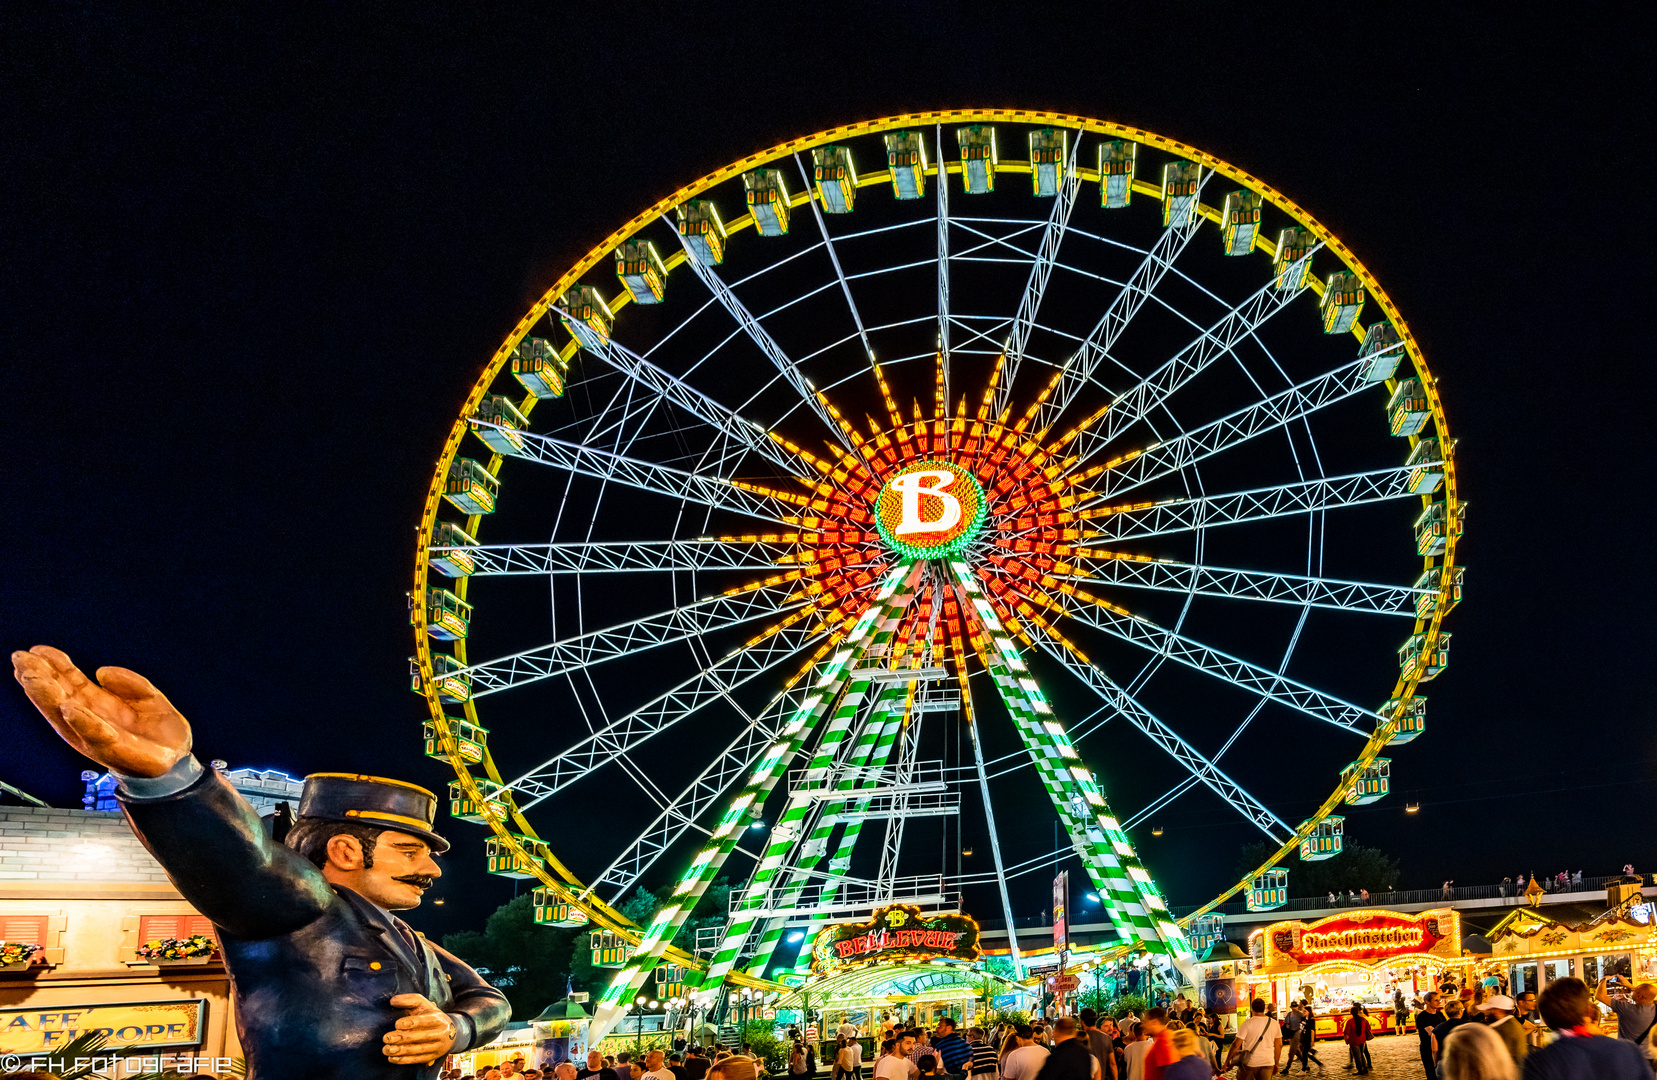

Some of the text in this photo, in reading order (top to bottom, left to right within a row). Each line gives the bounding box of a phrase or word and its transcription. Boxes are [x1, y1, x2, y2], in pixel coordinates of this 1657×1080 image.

[891, 470, 961, 535] B
[886, 909, 906, 928] B
[835, 930, 957, 958] BELLEVUE
[1304, 929, 1420, 950] Naschkästchen
